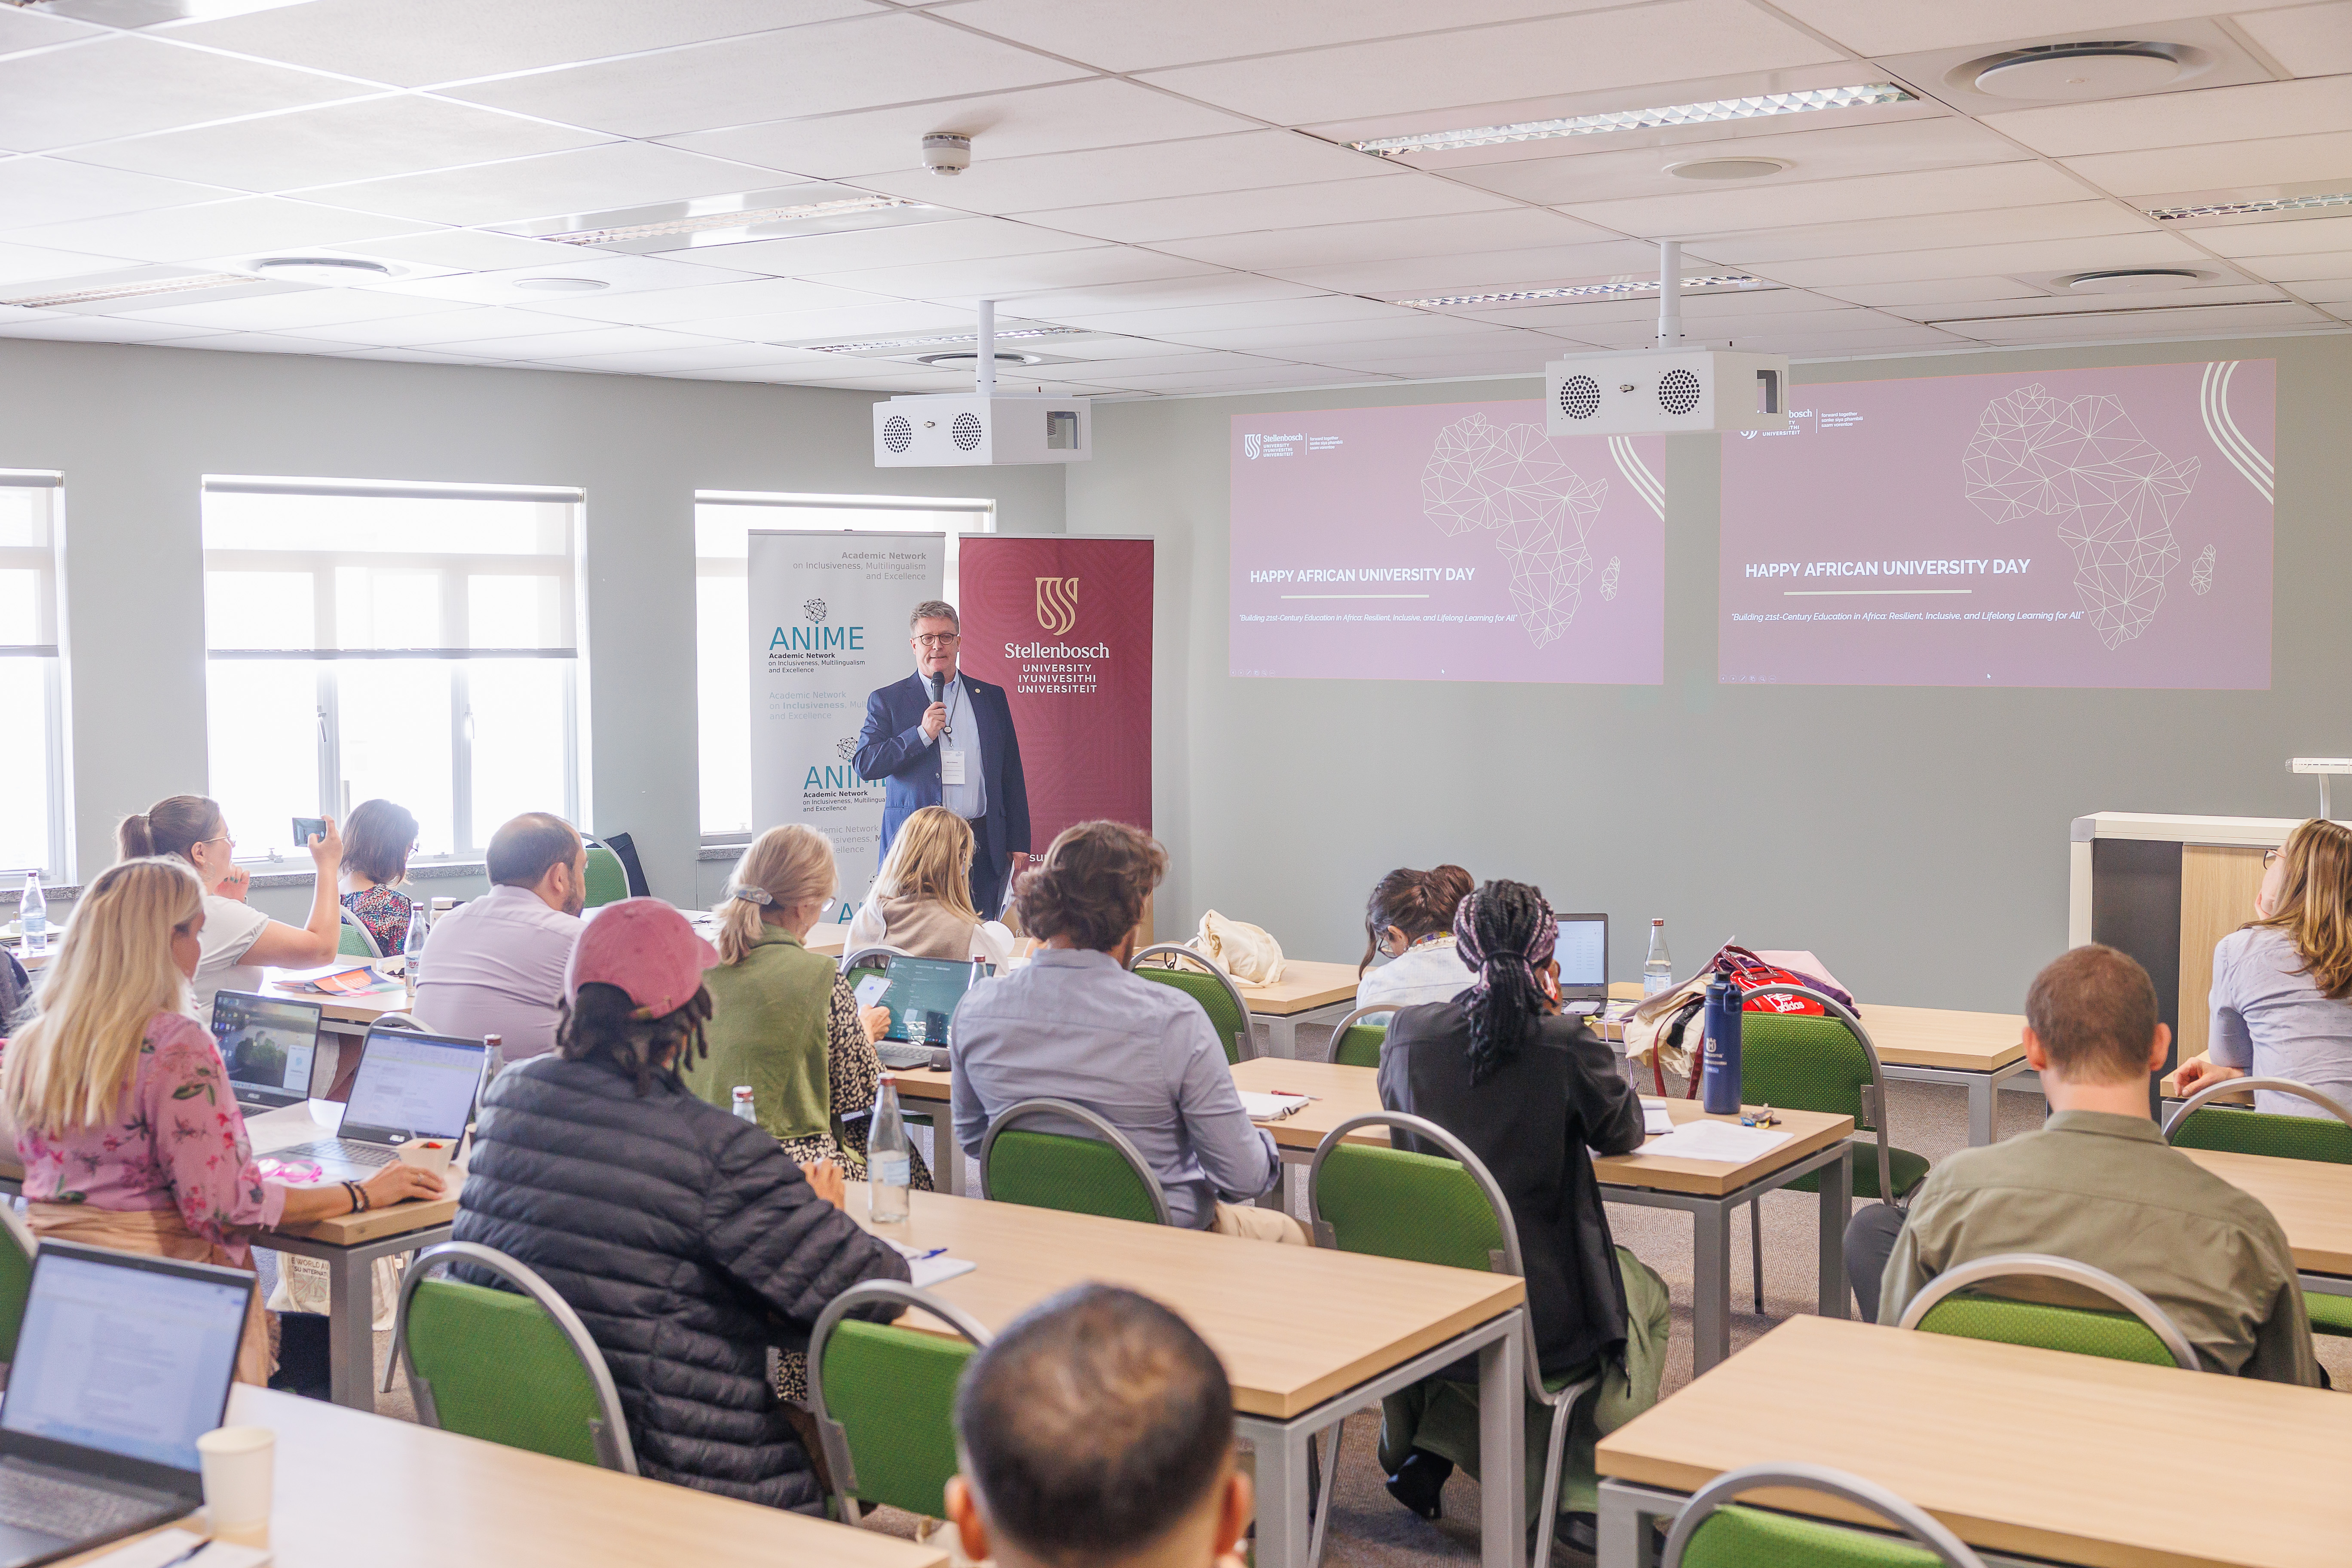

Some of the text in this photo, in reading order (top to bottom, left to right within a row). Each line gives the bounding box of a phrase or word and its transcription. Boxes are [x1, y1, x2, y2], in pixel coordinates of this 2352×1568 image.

[1263, 433, 1303, 442] Stellenbosch
[806, 562, 863, 570] Inclusiveness,
[866, 562, 926, 571] Multilingualism
[1745, 558, 2031, 578] HAPPY AFRICAN UNIVERSITY DAY
[1250, 567, 1476, 582] HAPPY AFRICAN UNIVERSITY DAY
[1266, 614, 1303, 622] 21st-Century
[1343, 614, 1363, 622] Africa:
[1437, 614, 1463, 623] Lifelong
[1465, 615, 1494, 623] Learning
[1494, 614, 1505, 623] for
[1765, 612, 1812, 622] 21st-Century
[1853, 612, 1860, 620] in
[1862, 612, 1888, 622] Africa:
[1889, 612, 1923, 621] Resilient,
[1925, 612, 1962, 620] Inclusive,
[1981, 611, 2015, 621] Lifelong
[2017, 611, 2054, 621] Learning
[2055, 610, 2068, 622] for
[769, 626, 864, 650] ANIME
[1004, 642, 1110, 658] Stellenbosch
[1023, 664, 1091, 672] UNIVERSITY
[1019, 674, 1096, 683] IYUNIVESITHI
[1017, 685, 1097, 693] UNIVERSITEIT
[1777, 1001, 1805, 1013] adidas
[297, 1258, 320, 1268] WORLD
